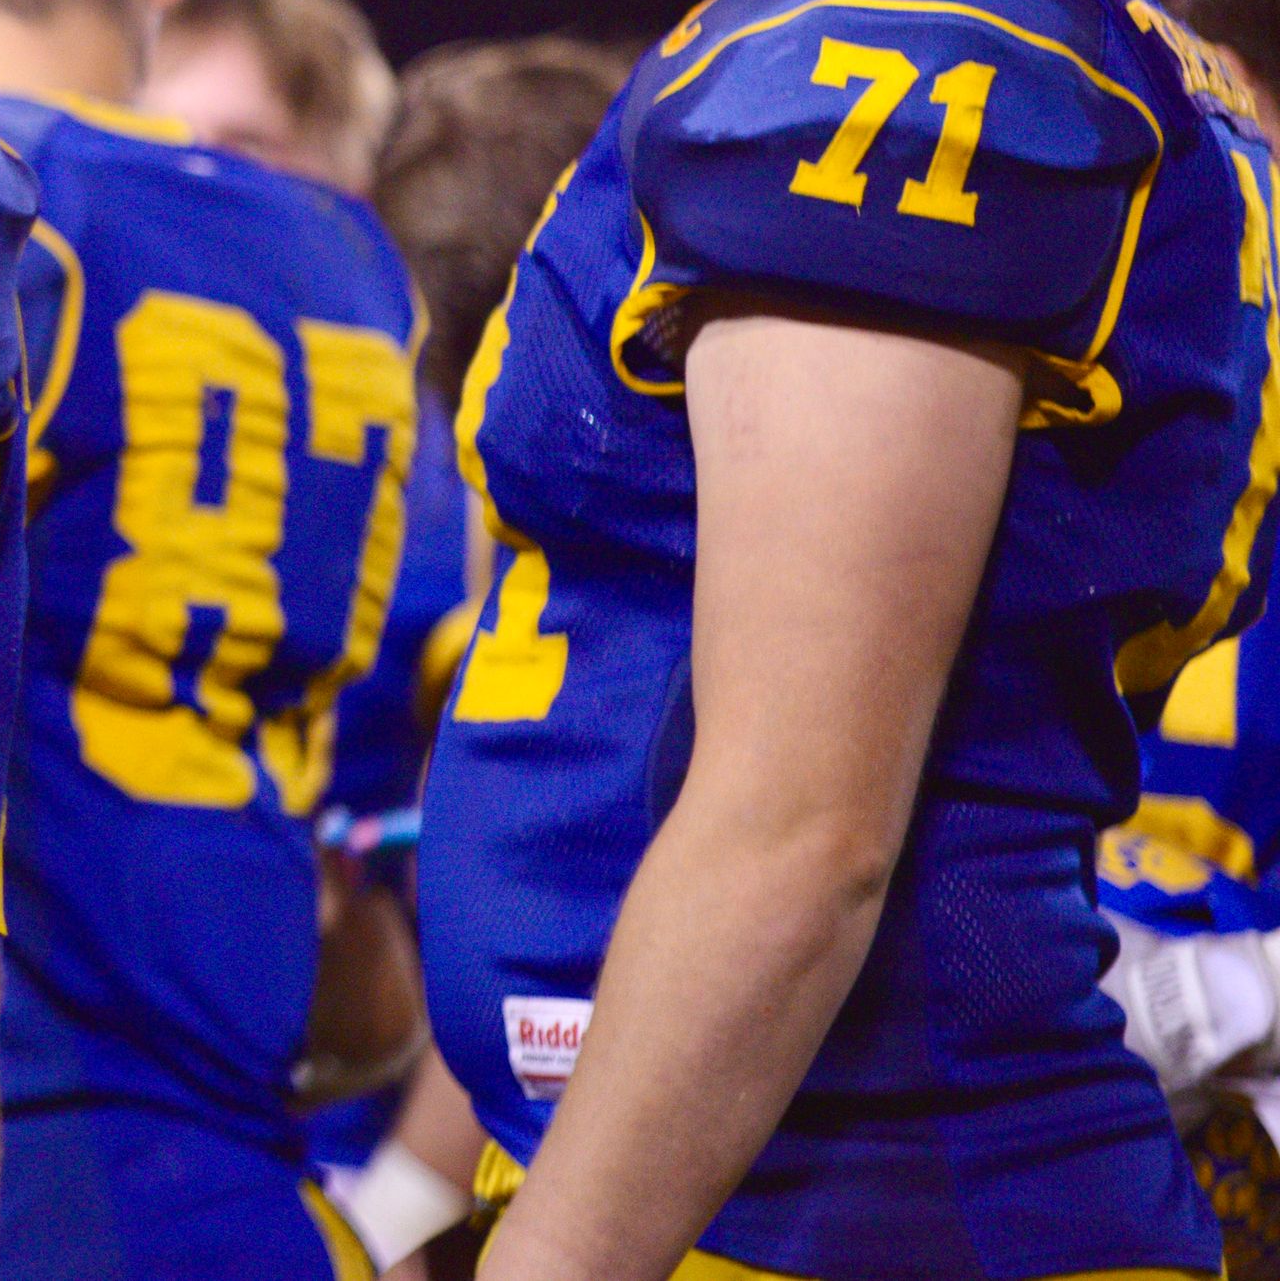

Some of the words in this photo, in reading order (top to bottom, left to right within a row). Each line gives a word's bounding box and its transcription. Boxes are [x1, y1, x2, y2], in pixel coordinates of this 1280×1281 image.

[789, 36, 997, 226] 71
[72, 288, 417, 817] 87
[519, 1017, 579, 1049] Ridd
